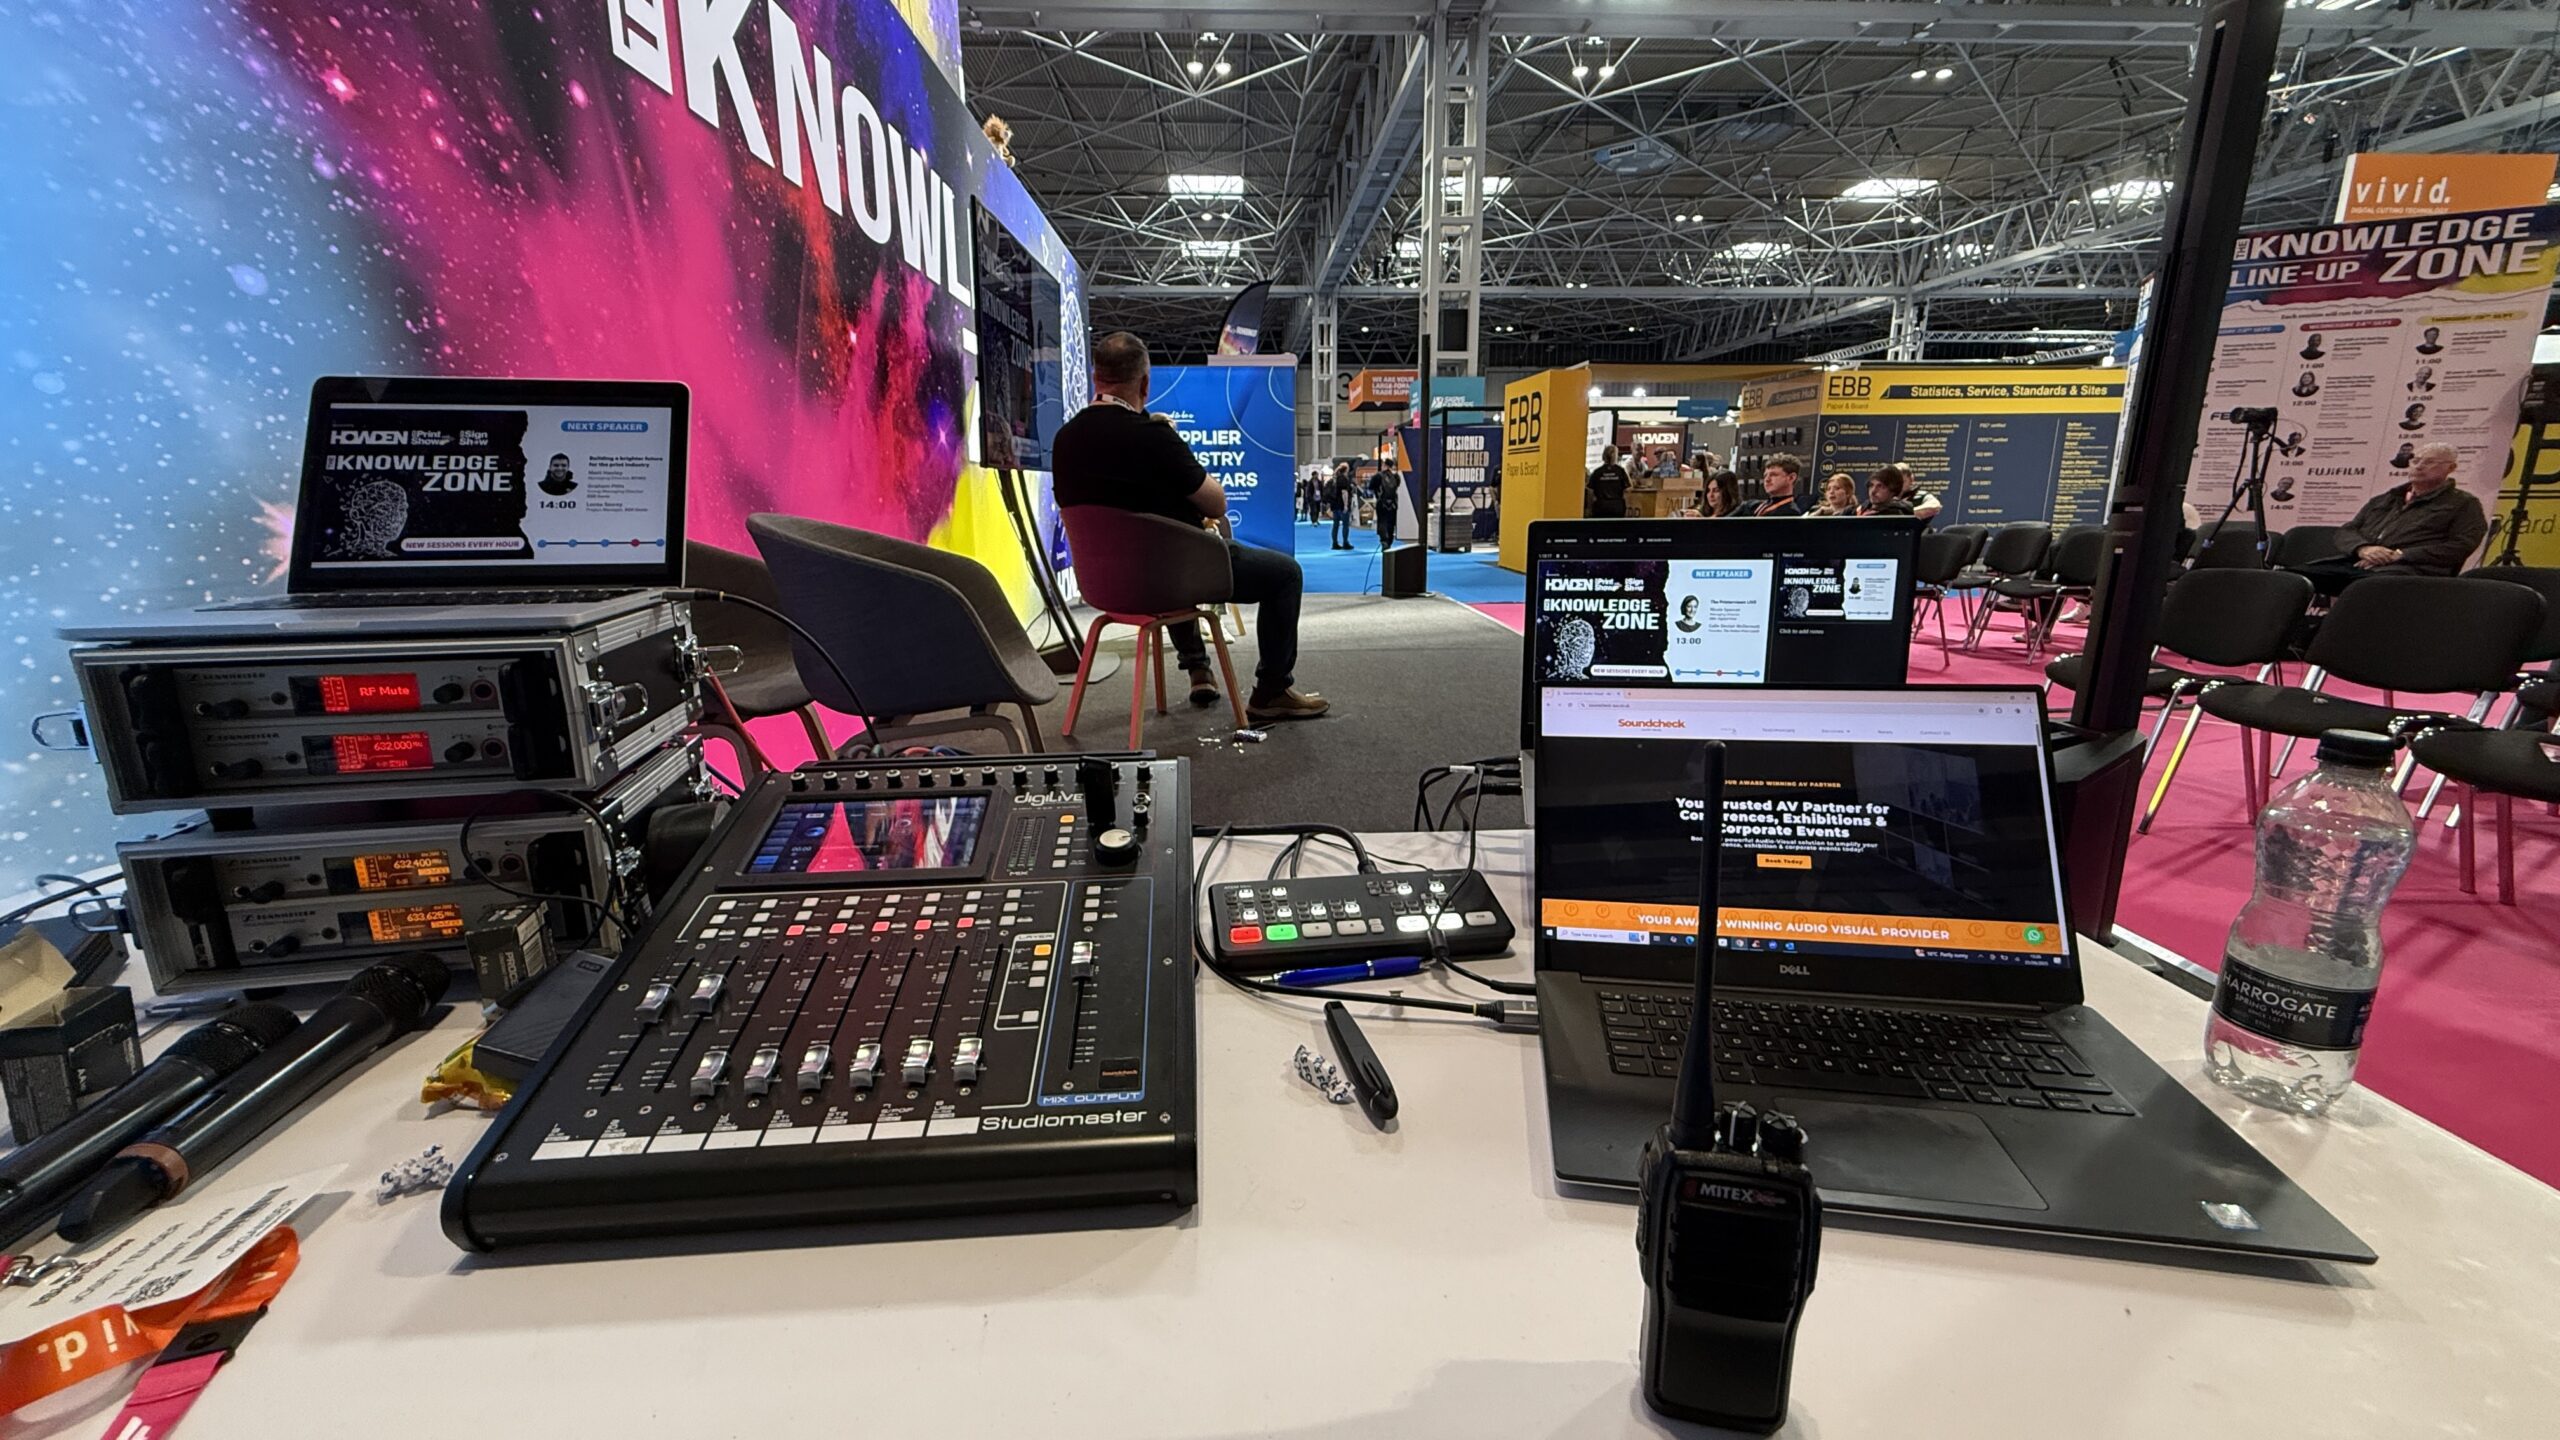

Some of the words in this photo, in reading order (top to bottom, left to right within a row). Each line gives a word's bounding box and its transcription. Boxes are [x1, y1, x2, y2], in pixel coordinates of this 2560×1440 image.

[677, 0, 975, 308] KNOWL
[2356, 176, 2451, 204] vivid.
[2250, 212, 2536, 260] KNOWLEDGE
[2233, 237, 2250, 261] THE
[2378, 239, 2550, 284] ZONE
[2229, 261, 2362, 288] LINE-UP
[1829, 376, 1872, 397] EBB
[1911, 386, 1964, 398] Statistics,
[1966, 386, 2009, 398] Service,
[2012, 385, 2066, 396] Standards
[2069, 385, 2077, 396] &
[2080, 384, 2108, 396] Sites
[1743, 387, 1764, 410] EBB
[567, 422, 594, 430] NEXT
[596, 422, 643, 431] SPEAKER
[1508, 391, 1542, 446] EBB
[330, 430, 409, 445] HOWDEN
[1178, 430, 1242, 445] PPLIER
[1446, 435, 1485, 451] DESIGNED
[336, 455, 499, 470] KNOWLEDGE
[1194, 451, 1245, 467] STRY
[1445, 451, 1490, 468] NGINEERED
[422, 472, 513, 492] ZONE
[1210, 472, 1258, 488] EARS
[539, 500, 576, 509] 14:00
[1812, 585, 1842, 593] ZONE
[1550, 598, 1652, 612] KNOWLEDGE
[1602, 613, 1660, 630] ZONE
[359, 686, 376, 696] RF
[379, 685, 410, 696] Mute
[1618, 718, 1686, 729] Soundcheck
[1675, 797, 1704, 809] You
[1722, 800, 1772, 811] rusted
[1776, 801, 1799, 812] AV
[1803, 802, 1862, 814] Partner
[1866, 803, 1890, 815] for
[1783, 813, 1871, 827] Exhibitions
[1875, 816, 1887, 827] &
[1797, 826, 1850, 838] Events
[1638, 914, 1671, 926] YOUR
[1724, 919, 1782, 932] WINNING
[1786, 922, 1828, 935] AUDIO
[1831, 924, 1878, 937] VISUAL
[1881, 927, 1950, 940] PROVIDER
[1779, 964, 1810, 976] DELL
[2222, 972, 2339, 1019] HARROGATE
[1043, 1095, 1068, 1105] MIX
[1075, 1091, 1141, 1103] OUTPUT
[982, 1109, 1147, 1131] Studiomaster
[1700, 1182, 1753, 1202] MITEX
